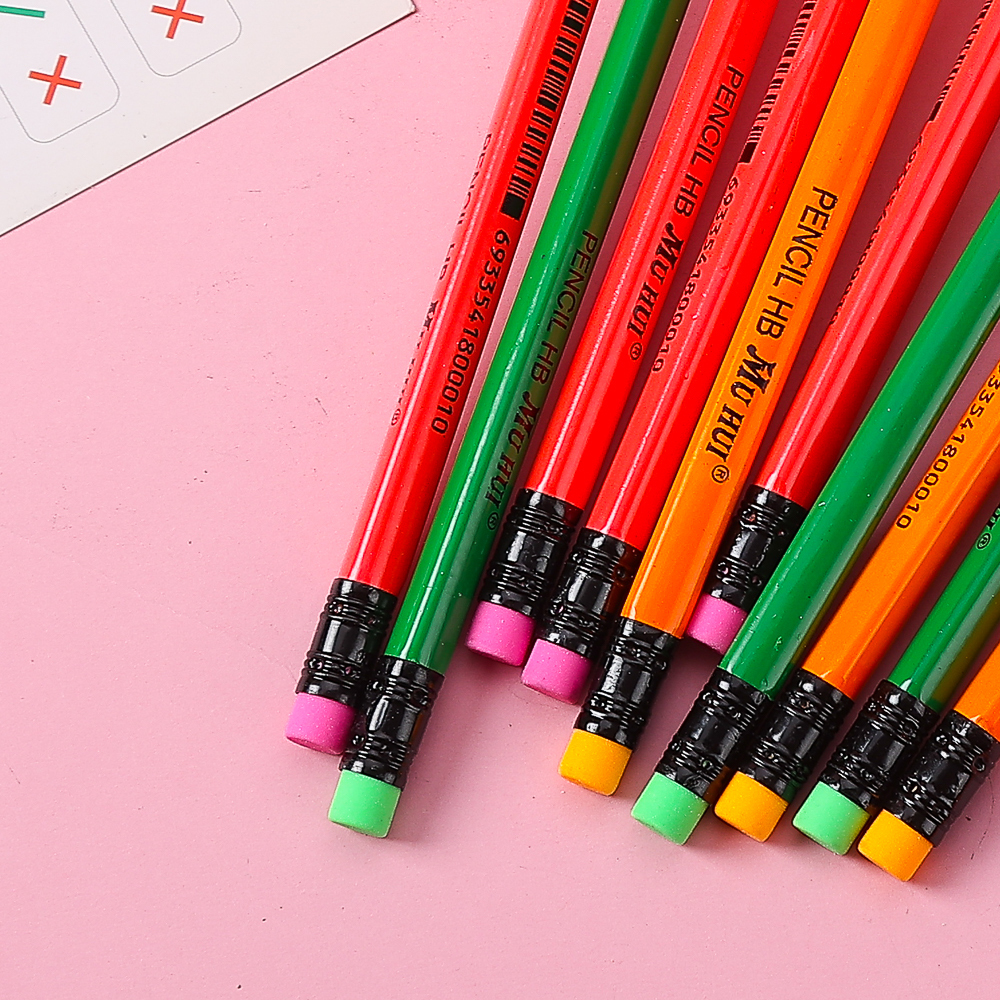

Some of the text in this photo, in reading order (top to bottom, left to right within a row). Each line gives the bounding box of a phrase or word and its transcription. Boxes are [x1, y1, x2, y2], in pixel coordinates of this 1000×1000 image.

[690, 63, 745, 164] PENCIL
[673, 172, 703, 218] HB
[772, 185, 839, 288] PENCIL
[431, 228, 511, 435] 6933541800010
[546, 229, 599, 333] PENCIL
[755, 294, 794, 340] HB
[530, 339, 559, 386] HB
